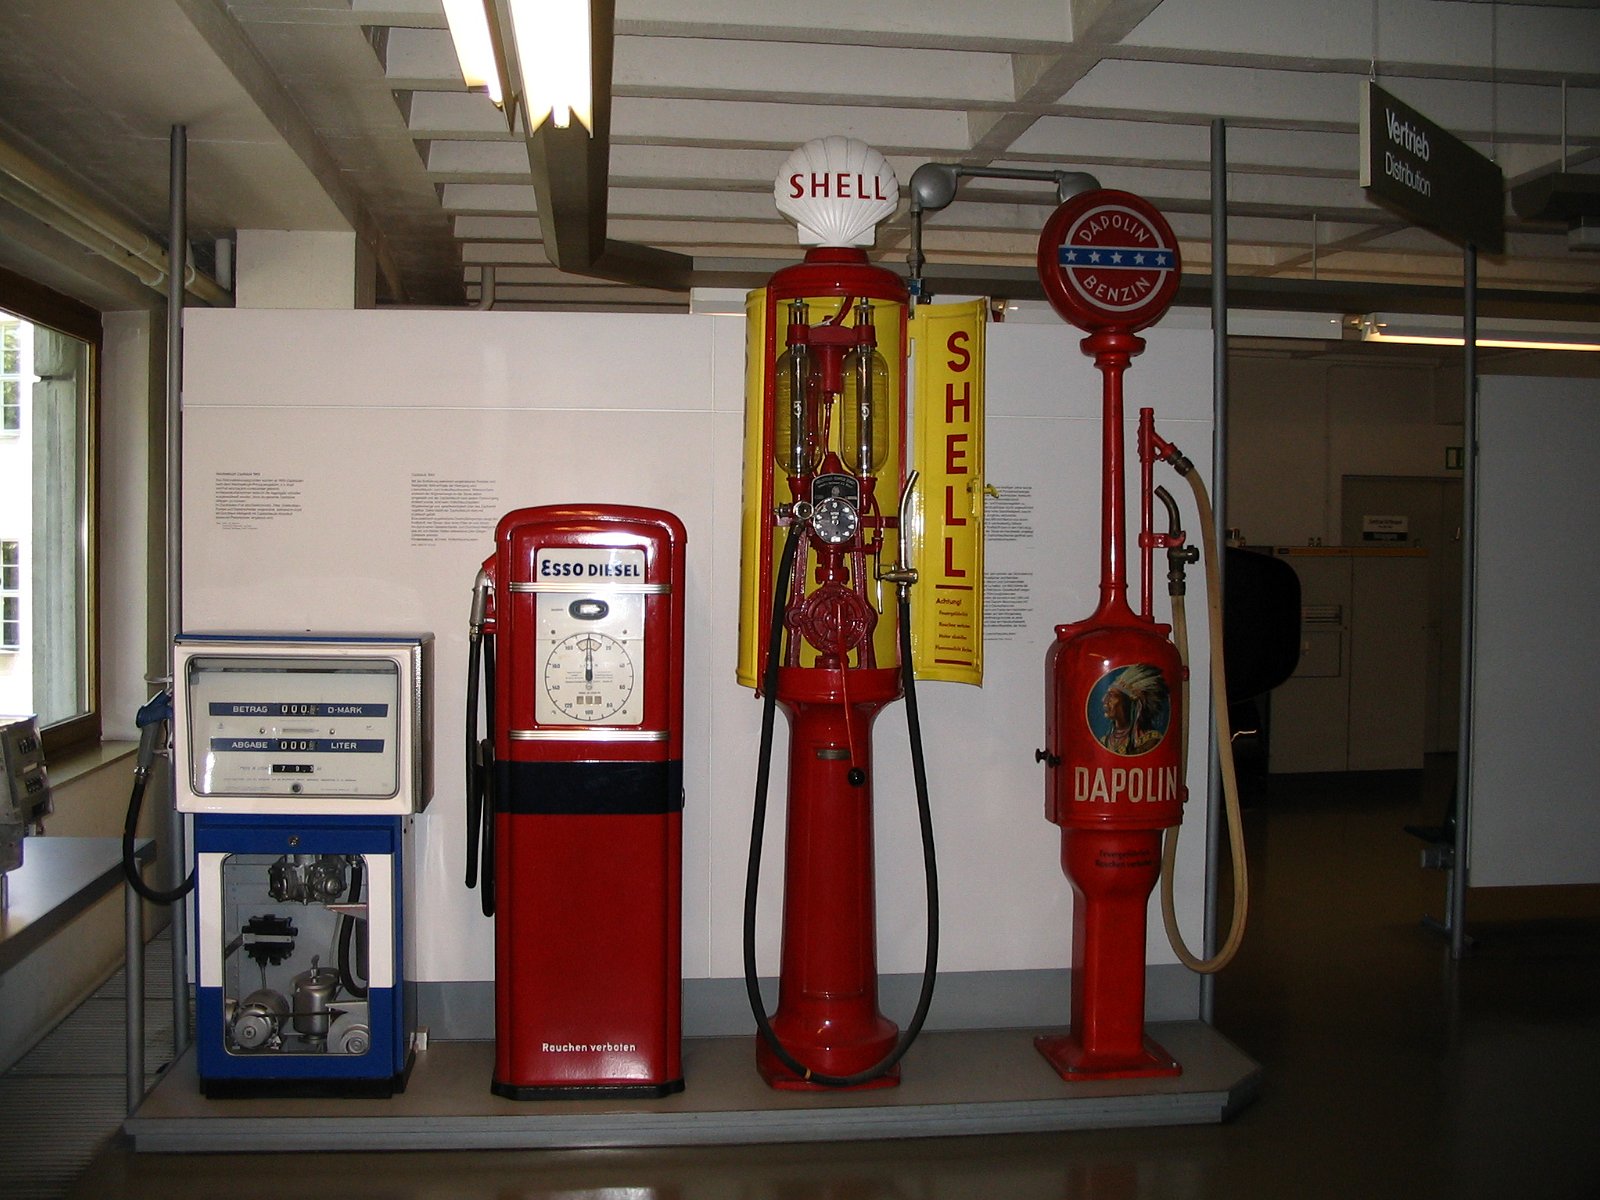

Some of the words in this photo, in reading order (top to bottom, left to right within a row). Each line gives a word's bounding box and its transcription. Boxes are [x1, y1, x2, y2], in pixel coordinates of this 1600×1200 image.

[1385, 108, 1430, 162] Vertrieb
[790, 172, 887, 200] SHELL
[1385, 151, 1431, 198] Distribution
[1079, 214, 1150, 243] DAPOLIN
[1083, 275, 1152, 302] BENZIN
[944, 330, 972, 578] SHELL
[588, 563, 641, 577] DIESEL
[232, 705, 269, 714] BETRAG
[327, 706, 363, 715] D-MARK
[231, 741, 269, 749] ABGABE
[330, 742, 358, 750] LITER
[1073, 766, 1178, 804] DAPOLIN
[542, 1042, 588, 1053] Rauchen
[590, 1041, 636, 1053] verboten
